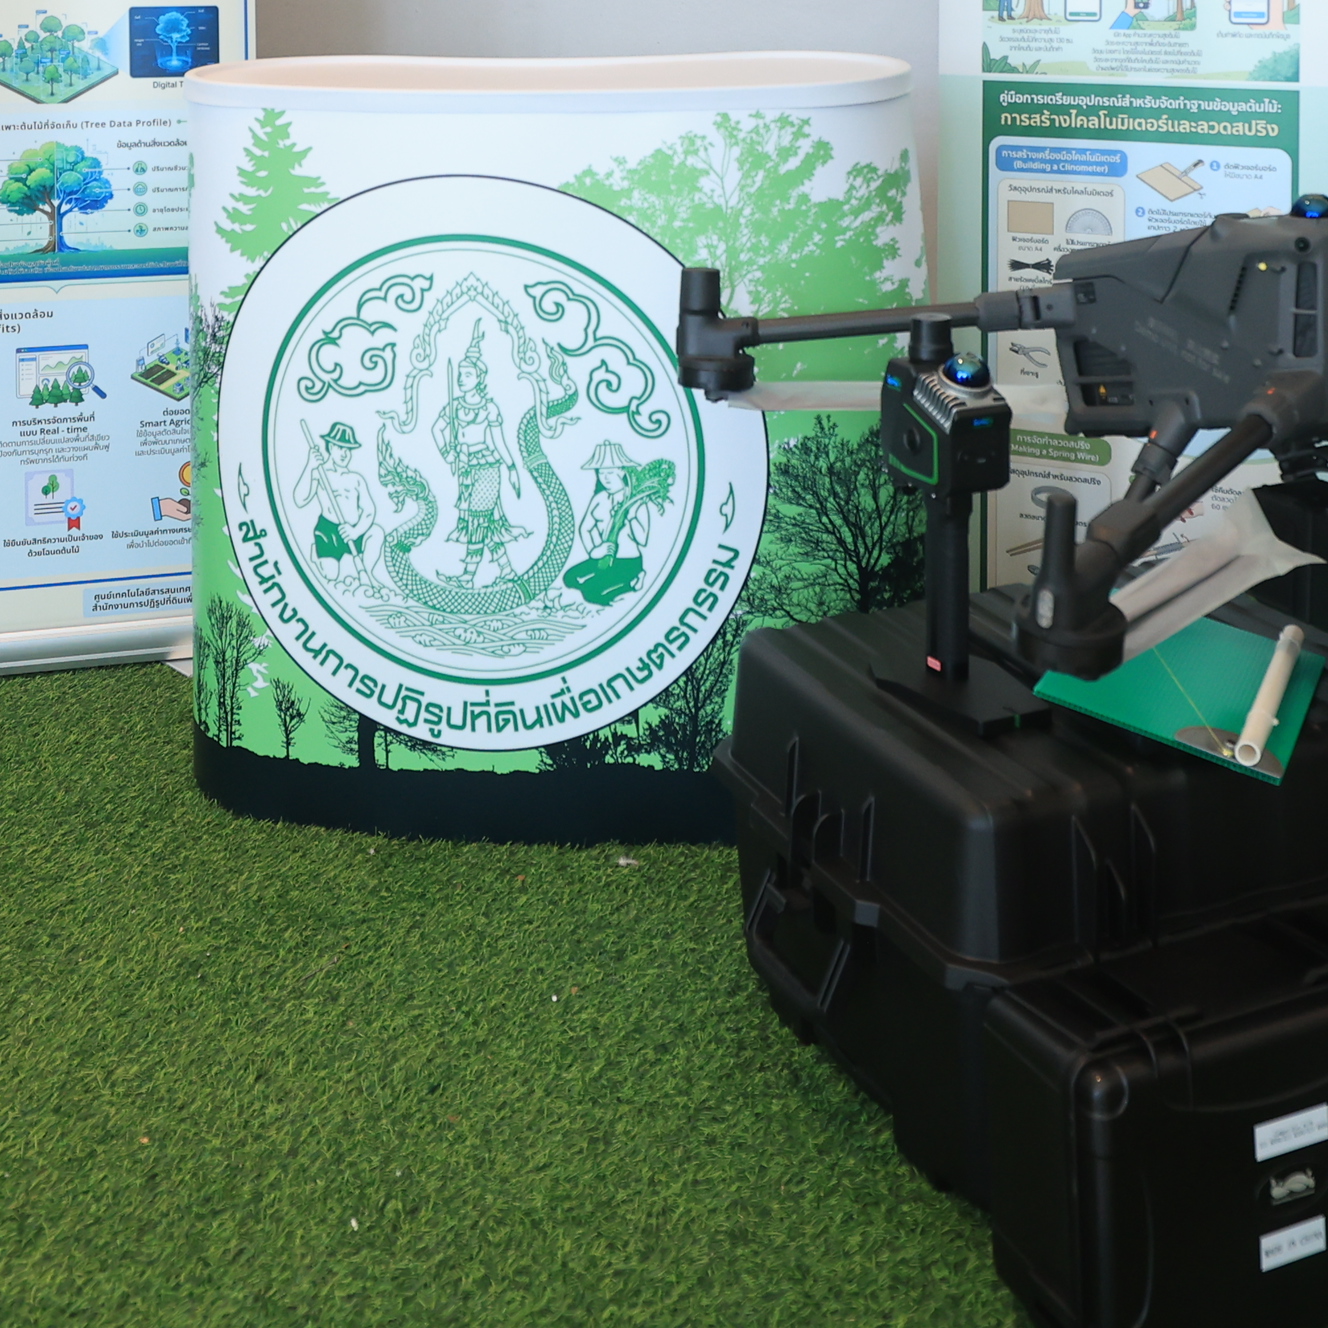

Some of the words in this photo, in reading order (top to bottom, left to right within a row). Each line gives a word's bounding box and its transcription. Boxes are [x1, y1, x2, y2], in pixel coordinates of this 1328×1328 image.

[152, 81, 178, 90] Digital
[80, 120, 106, 130] (Tree
[109, 120, 133, 129] Data
[135, 118, 172, 128] Profile)
[1013, 160, 1051, 173] (Building
[1058, 162, 1109, 174] Clinometer)
[39, 427, 59, 436] Real
[67, 425, 88, 434] time
[139, 420, 167, 429] Smart
[1048, 448, 1074, 461] Spring
[1075, 450, 1100, 463] Wire)
[238, 519, 740, 738] สำนักงานการปฏิรูปที่ดินเพื่อเกษตรกรรม
